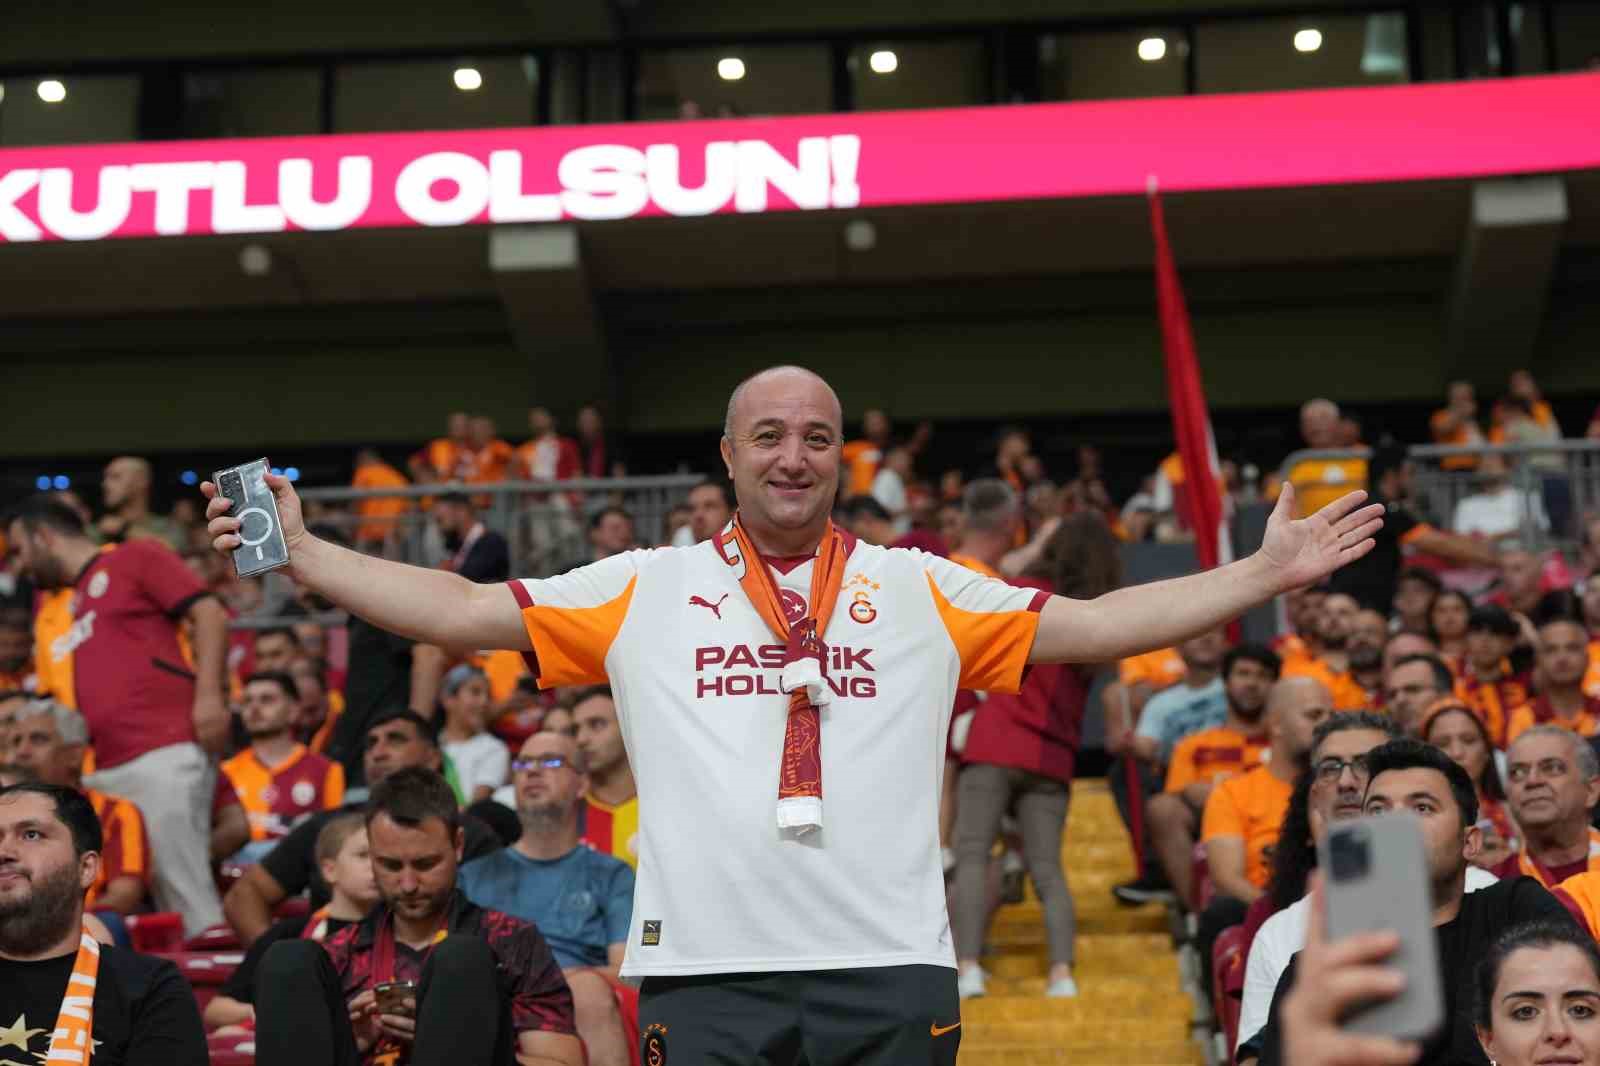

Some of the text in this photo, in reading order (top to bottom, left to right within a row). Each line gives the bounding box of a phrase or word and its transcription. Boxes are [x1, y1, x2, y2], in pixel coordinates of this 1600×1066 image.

[0, 134, 860, 241] KUTLU OLSUN!
[695, 645, 876, 671] PASİK
[697, 674, 877, 698] HOLNG
